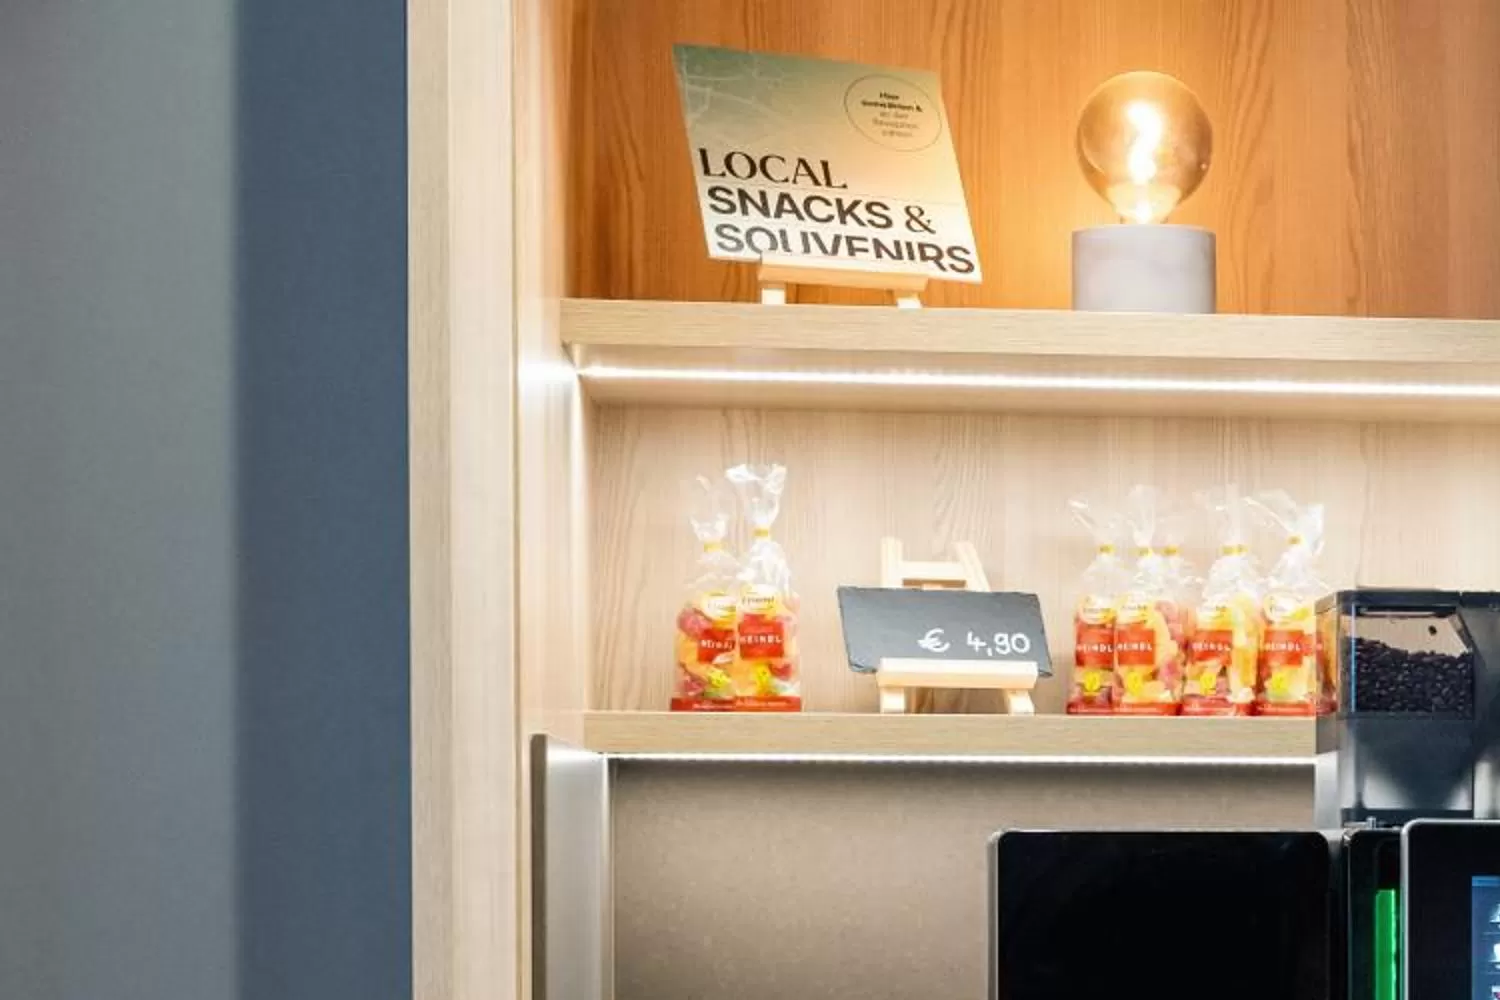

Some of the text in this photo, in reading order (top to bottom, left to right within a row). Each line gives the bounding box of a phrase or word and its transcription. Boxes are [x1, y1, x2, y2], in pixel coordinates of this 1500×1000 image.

[698, 147, 848, 189] LOCAL
[706, 184, 937, 235] SNACKS &
[714, 222, 976, 274] SOUVENIRS
[916, 628, 1031, 657] € 4,90
